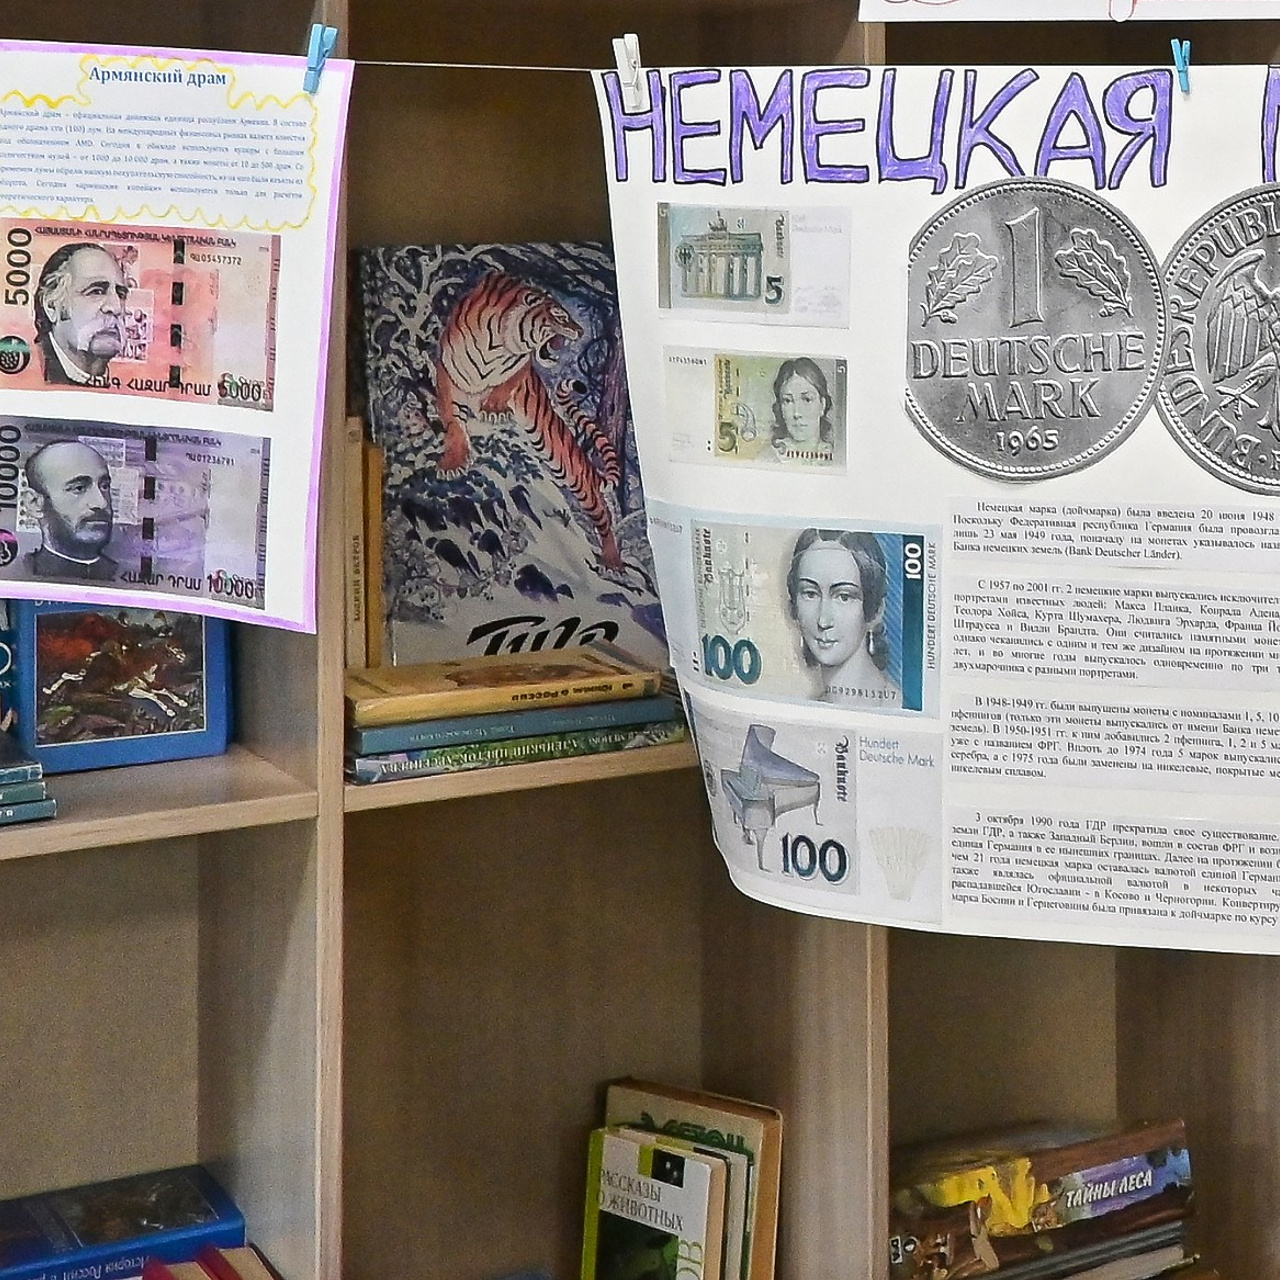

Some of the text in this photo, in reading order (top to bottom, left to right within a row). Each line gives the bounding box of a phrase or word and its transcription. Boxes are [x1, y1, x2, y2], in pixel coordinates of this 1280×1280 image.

[89, 67, 227, 88] Армянский драм
[602, 67, 1174, 194] НЕМЕЦКАЯ
[2, 227, 32, 308] 5000
[1004, 207, 1045, 328] 1
[763, 275, 786, 306] 5
[910, 332, 1149, 382] DEUTSCHE
[956, 378, 1102, 423] MARK
[715, 423, 740, 455] 5
[995, 428, 1060, 455] 1965
[977, 502, 1023, 514] Немецкая
[1028, 505, 1057, 516] марка
[1126, 506, 1151, 517] была
[1157, 509, 1195, 520] введена
[1201, 510, 1213, 520] 20
[1219, 512, 1245, 521] июня
[1252, 510, 1275, 521] 1948
[904, 541, 923, 581] 100
[700, 633, 764, 687] 100
[859, 736, 901, 751] Hundert
[859, 749, 936, 768] Deutsche Mark
[780, 834, 848, 885] 100
[600, 1169, 661, 1202] РАССКАЗЫ
[1065, 1169, 1153, 1209] ТАЙНЫ ЛЕСА
[608, 1193, 683, 1232] ЖИВОТНЫХ
